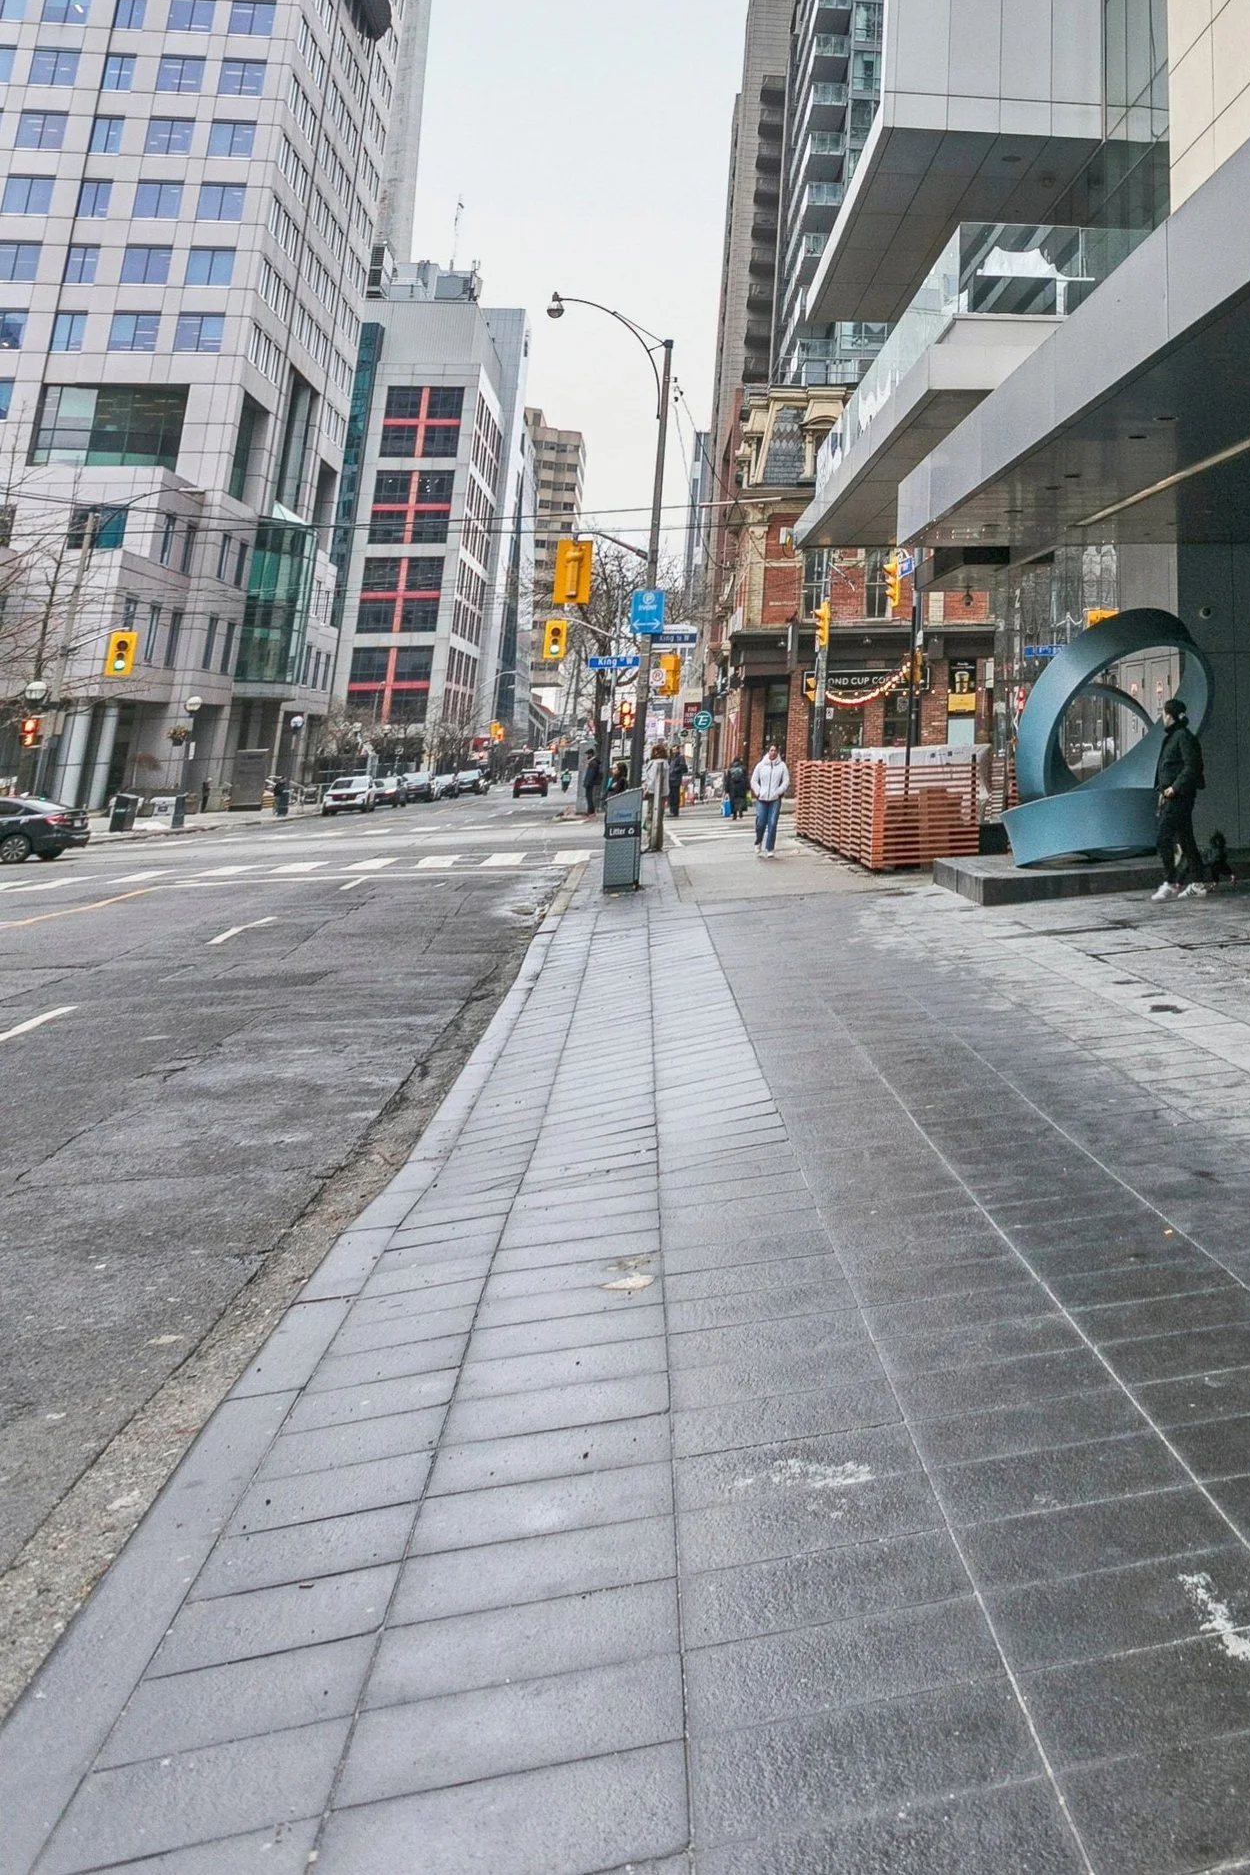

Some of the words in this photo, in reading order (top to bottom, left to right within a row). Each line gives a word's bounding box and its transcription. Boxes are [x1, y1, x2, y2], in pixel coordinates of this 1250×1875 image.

[597, 657, 618, 668] King
[626, 656, 633, 665] W
[827, 676, 849, 685] OND
[850, 676, 870, 685] CUP
[871, 675, 907, 684] COFEE
[609, 827, 626, 836] Litter
